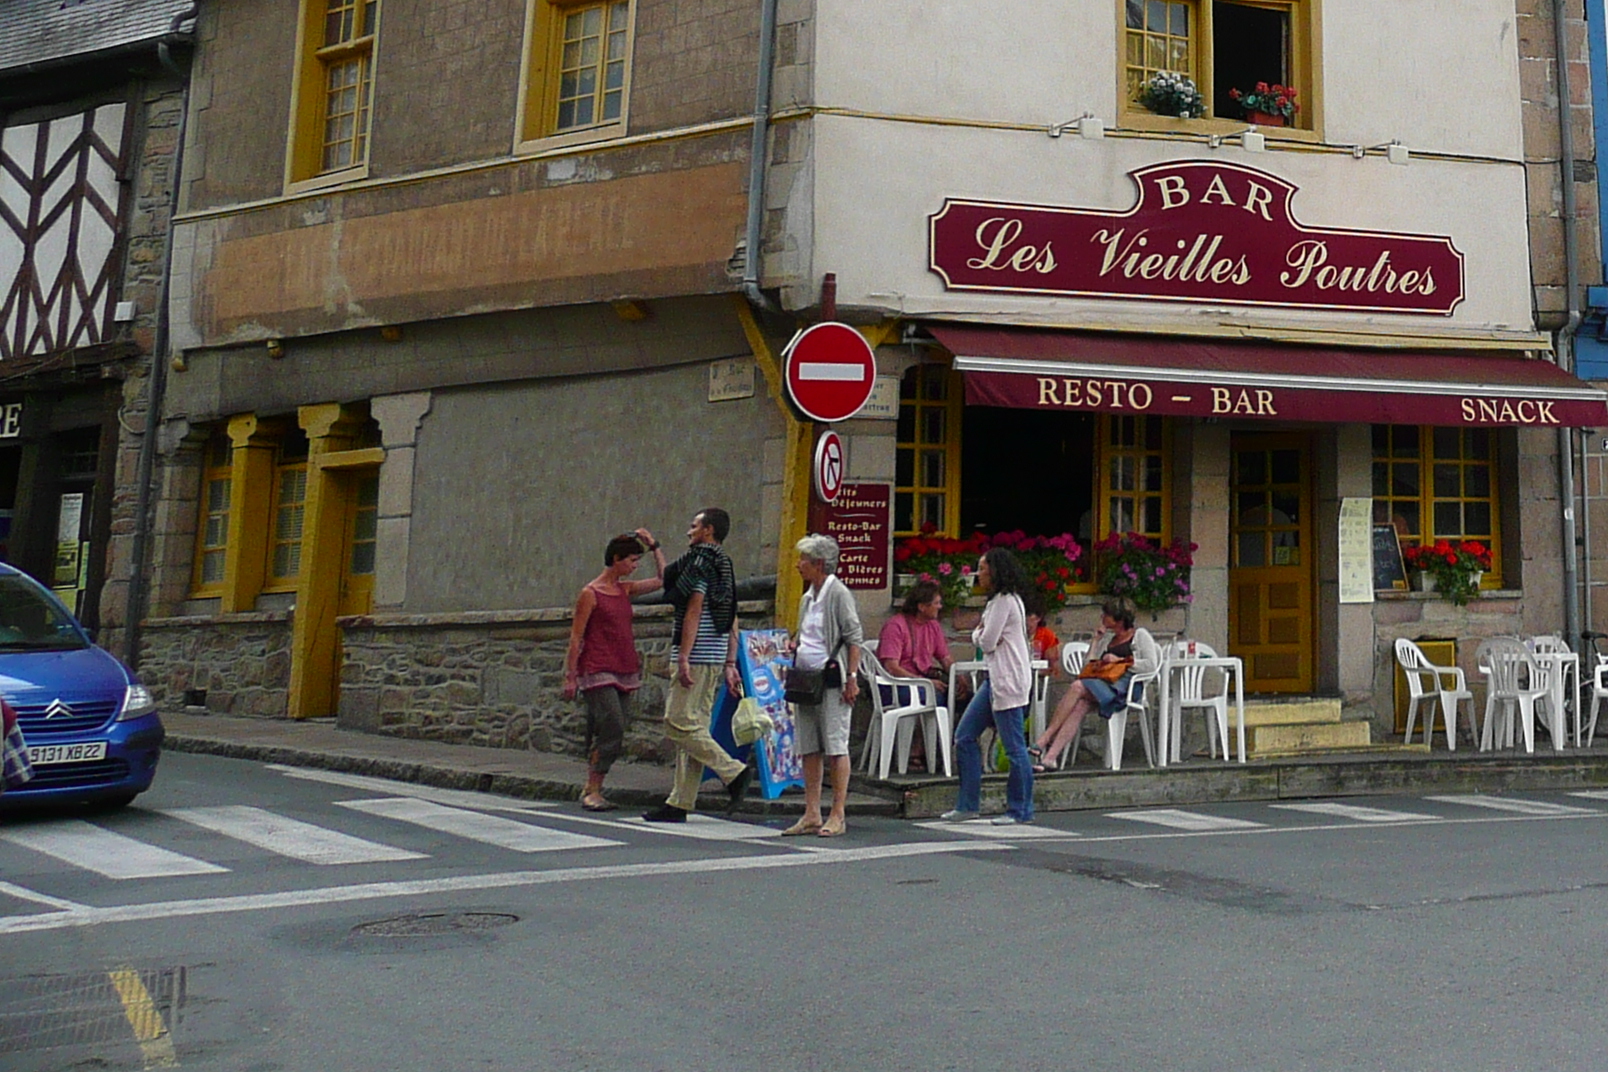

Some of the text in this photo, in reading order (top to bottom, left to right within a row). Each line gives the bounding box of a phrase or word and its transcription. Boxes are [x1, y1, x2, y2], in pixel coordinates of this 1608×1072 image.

[1154, 173, 1273, 221] BAR
[966, 216, 1438, 296] Les Vieilles Poutres
[1037, 377, 1153, 409] RESTO
[1210, 387, 1278, 415] BAR
[1461, 397, 1560, 424] SNACK
[828, 521, 882, 531] Resto-Bar
[838, 532, 871, 543] Snack
[839, 553, 868, 563] Carte
[30, 744, 101, 763] 9131 XB 22
